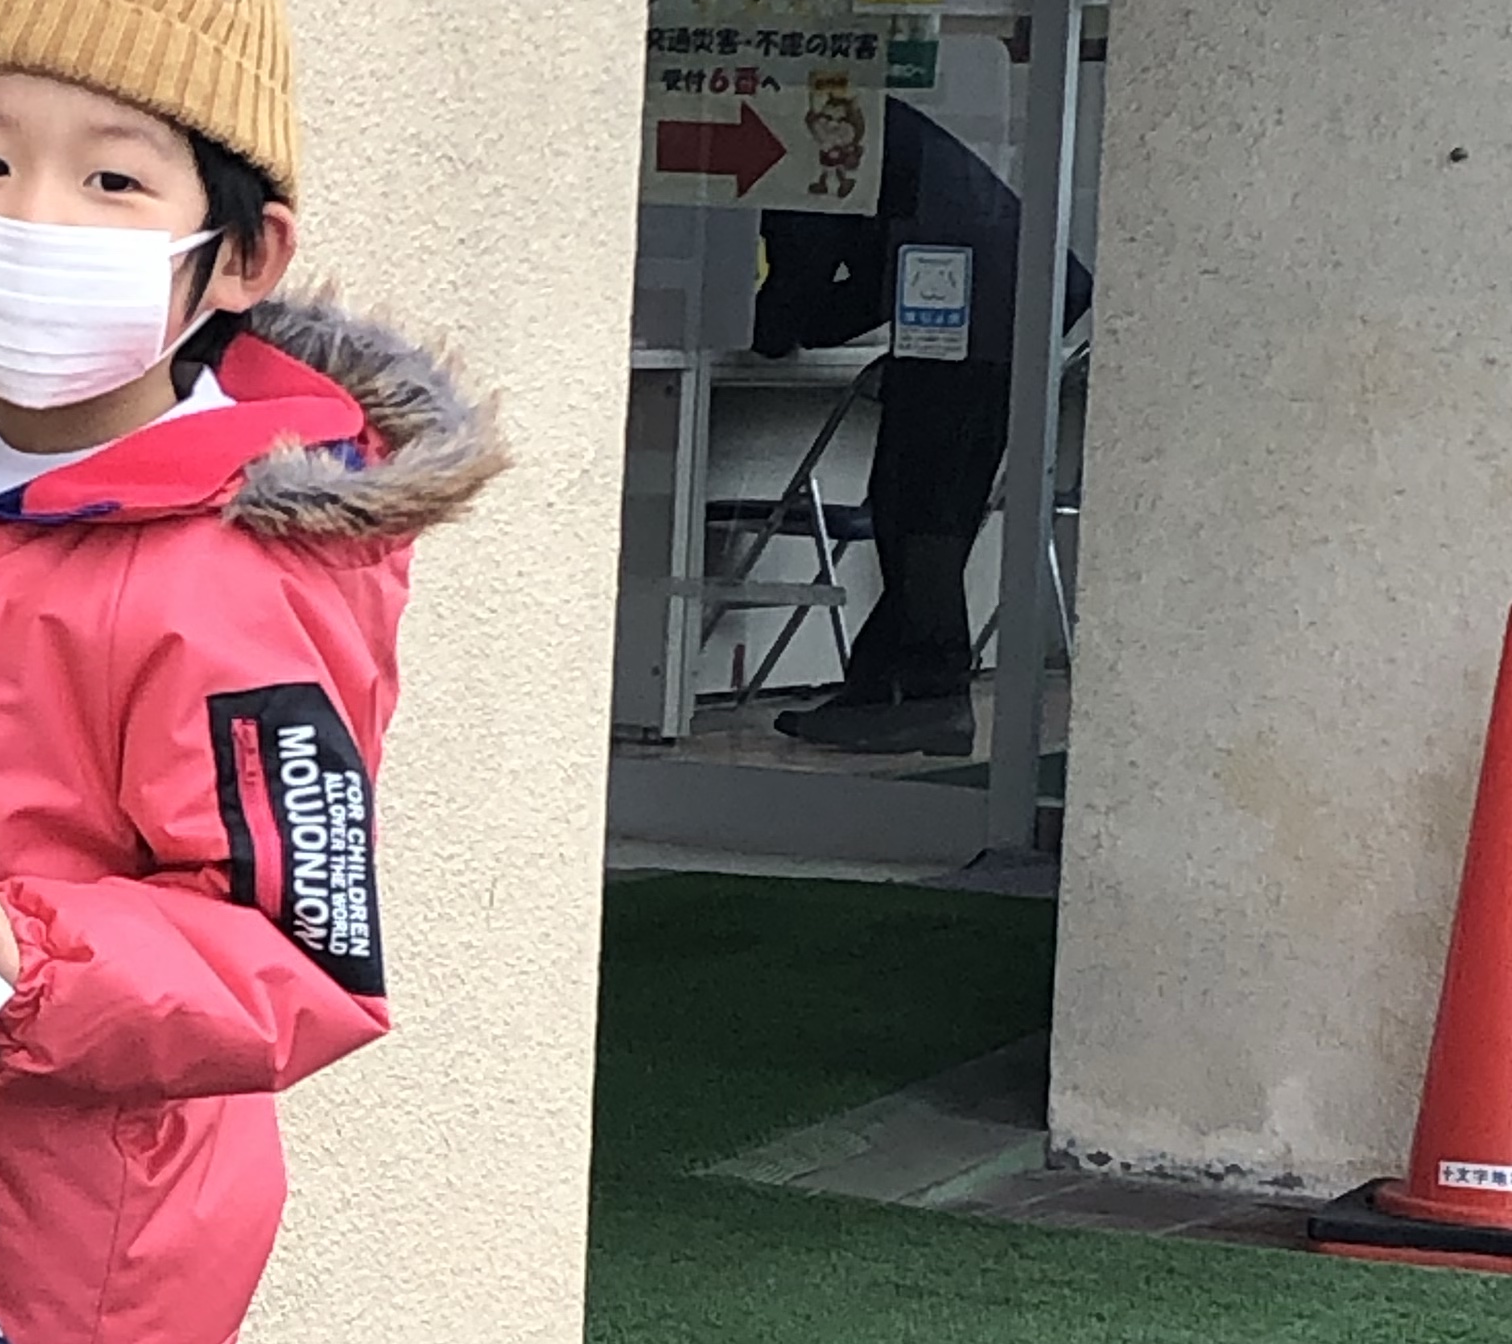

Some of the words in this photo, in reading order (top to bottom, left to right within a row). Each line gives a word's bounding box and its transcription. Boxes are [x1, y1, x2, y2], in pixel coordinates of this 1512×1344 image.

[662, 66, 781, 96] 受付6番へ
[323, 771, 345, 804] ALL
[345, 770, 365, 821] FOR
[277, 725, 331, 951] MOUJONJON
[329, 805, 346, 851] OVER
[330, 855, 346, 889] THE
[347, 827, 370, 957] CHILDREN
[330, 892, 348, 956] WORLD
[1442, 1165, 1512, 1187] 十文字地
